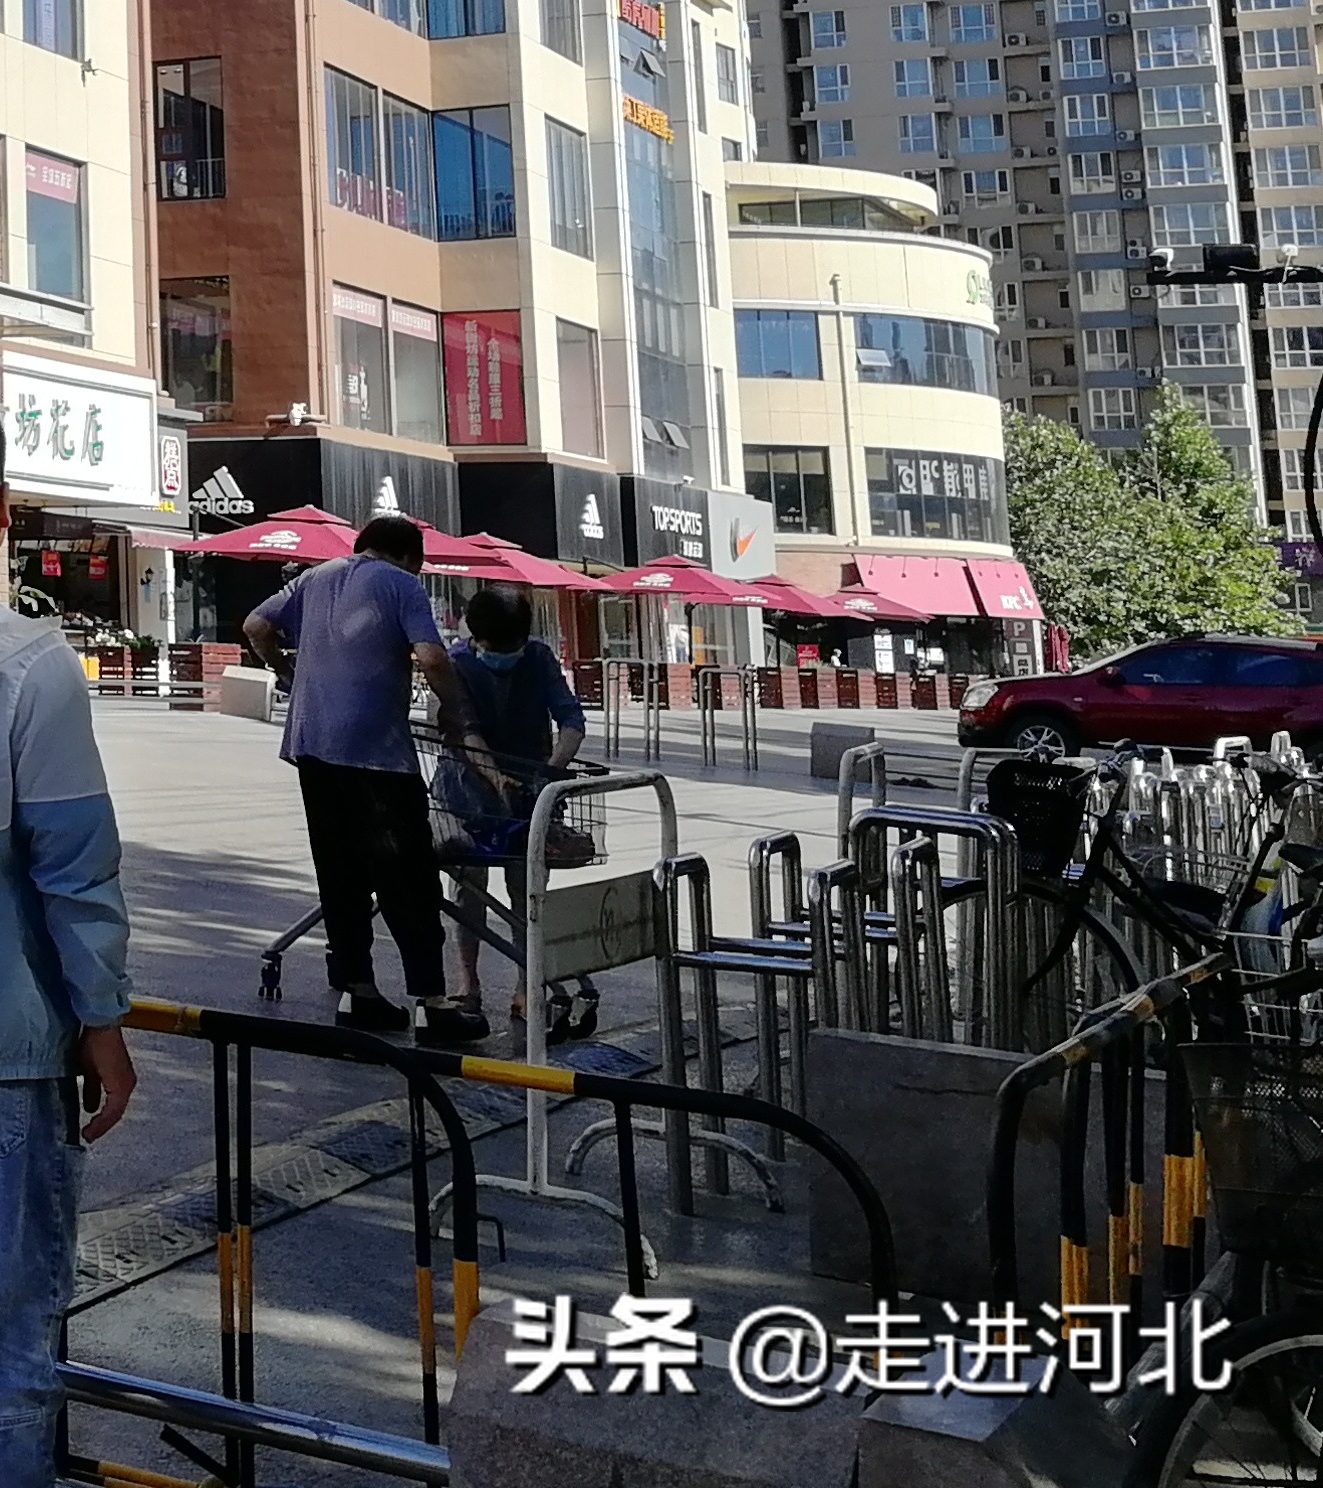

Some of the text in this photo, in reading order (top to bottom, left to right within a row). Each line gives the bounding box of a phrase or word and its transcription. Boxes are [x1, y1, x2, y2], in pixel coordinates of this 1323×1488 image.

[13, 392, 105, 467] 坊花店
[651, 505, 703, 536] TOPSPORTS
[1000, 595, 1023, 610] KFC
